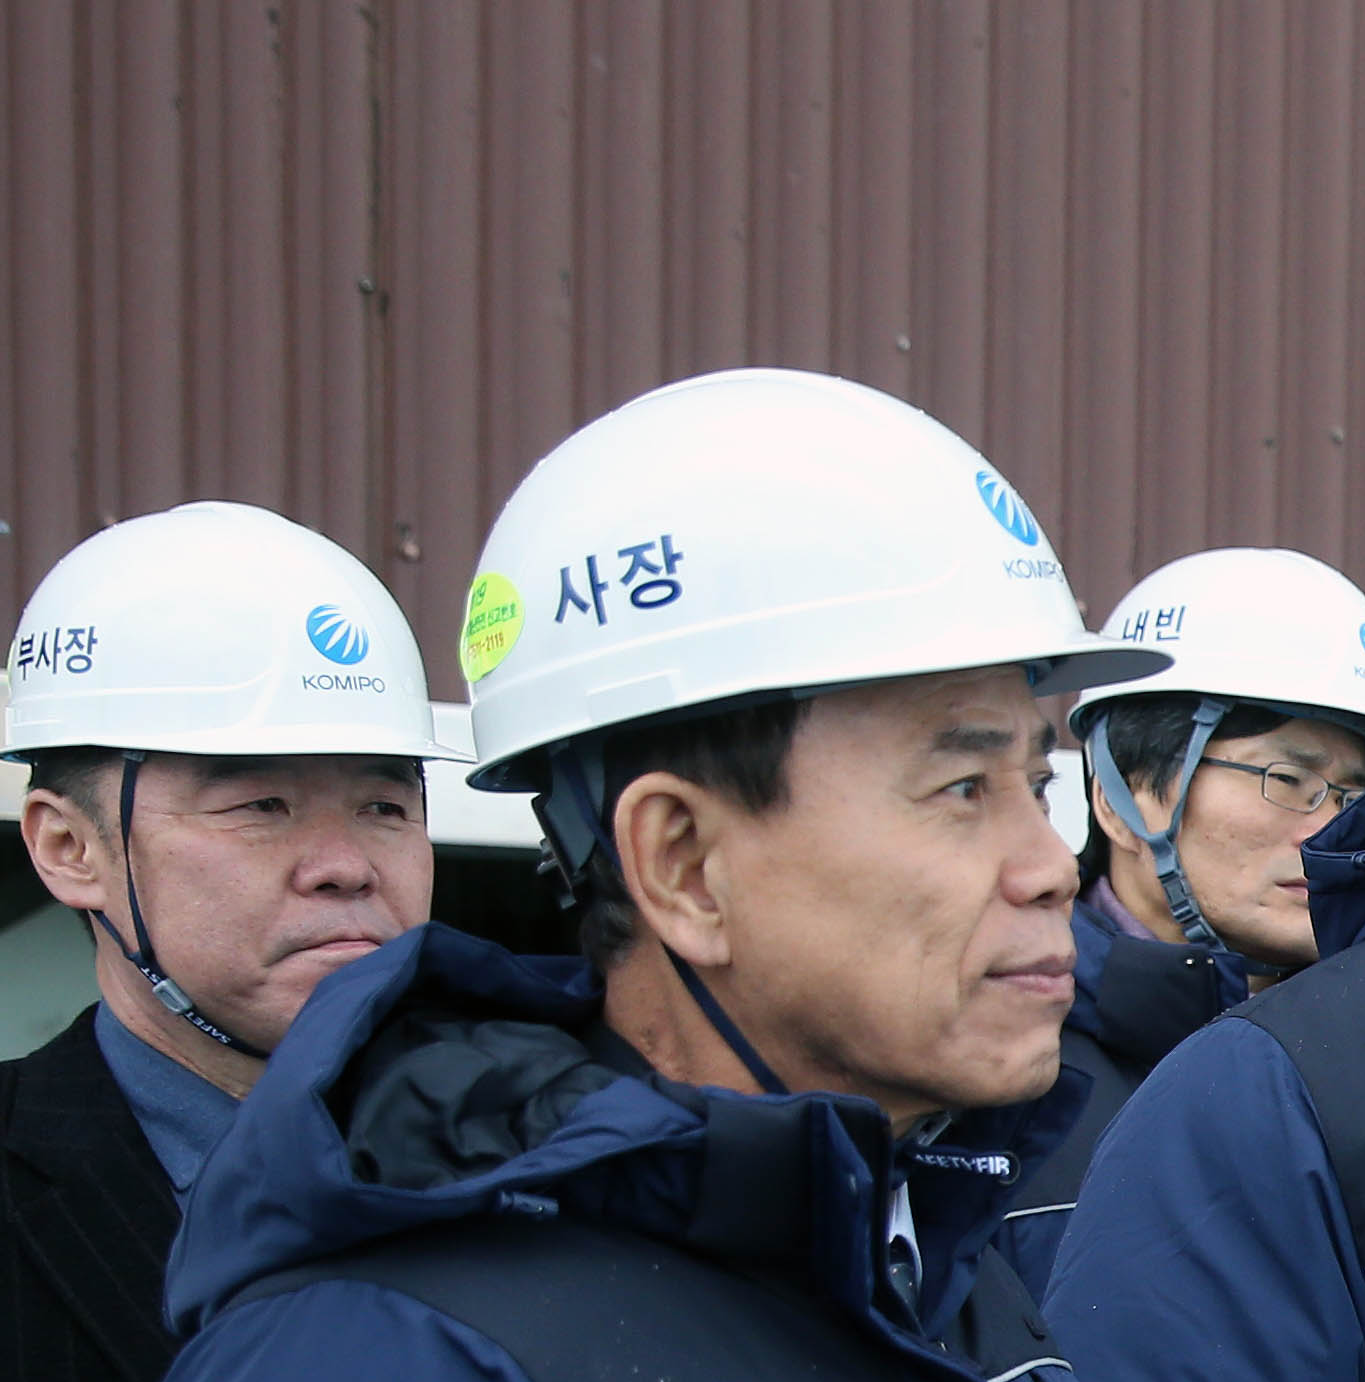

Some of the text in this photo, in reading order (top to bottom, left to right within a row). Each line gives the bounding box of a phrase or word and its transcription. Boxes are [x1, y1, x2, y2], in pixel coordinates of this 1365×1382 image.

[554, 533, 685, 628] 사장
[1122, 605, 1186, 642] 내빈
[17, 626, 98, 681] 부사장
[302, 674, 385, 694] KOMIPO
